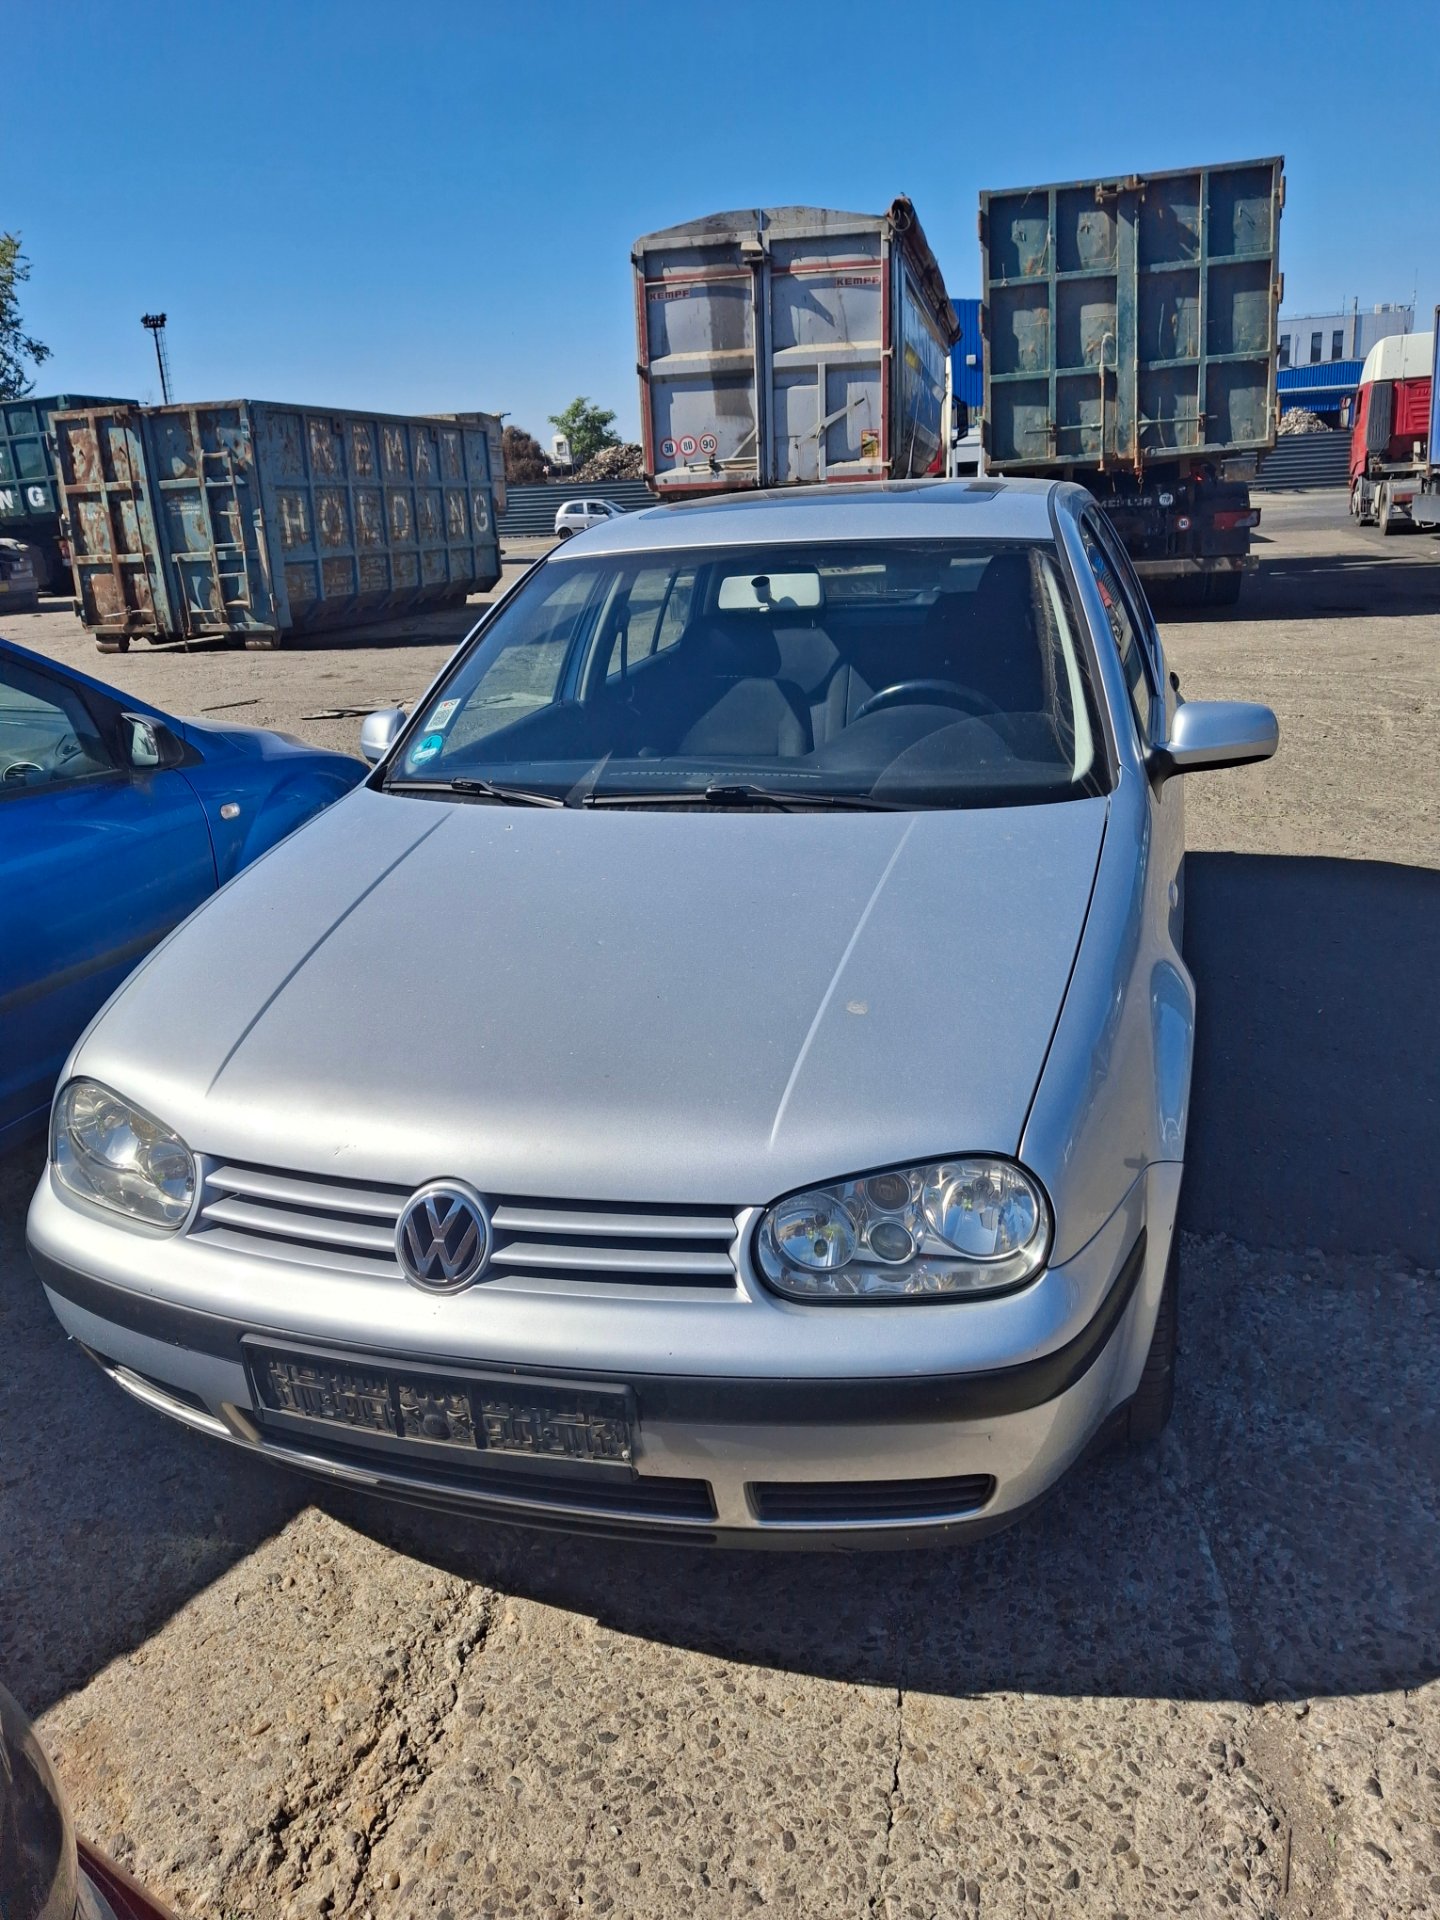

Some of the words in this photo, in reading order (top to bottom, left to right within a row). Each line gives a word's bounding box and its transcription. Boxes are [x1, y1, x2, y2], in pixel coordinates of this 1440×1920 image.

[836, 276, 880, 286] KEMPF
[649, 290, 690, 300] KEMPF
[309, 420, 460, 477] REMAT
[664, 443, 674, 453] 50
[683, 440, 693, 451] 80
[702, 439, 715, 449] 90
[281, 492, 489, 547] HOLDING
